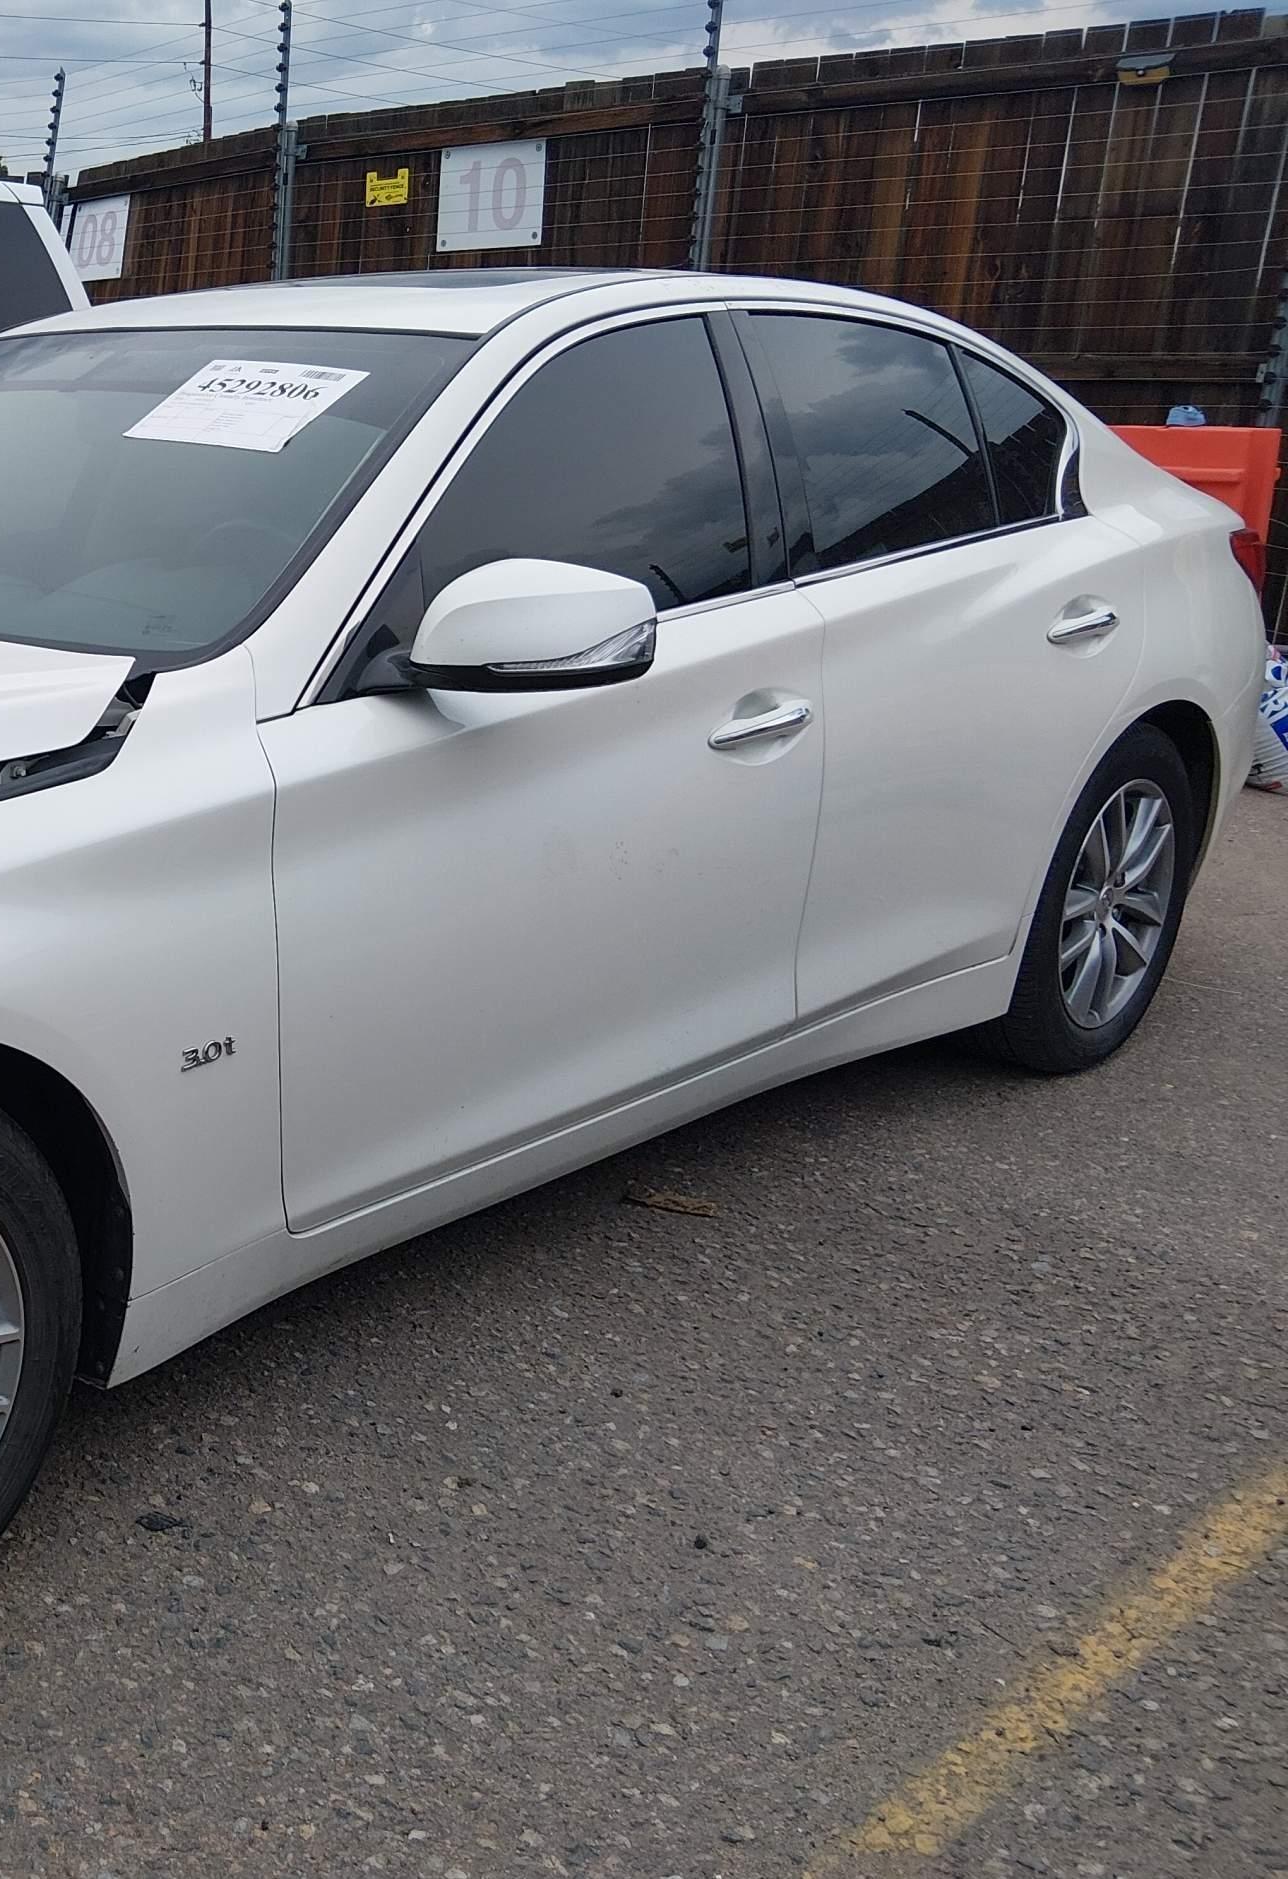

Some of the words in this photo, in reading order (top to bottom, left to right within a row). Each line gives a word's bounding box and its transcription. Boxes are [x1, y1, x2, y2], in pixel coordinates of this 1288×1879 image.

[459, 157, 527, 232] 10
[77, 211, 117, 269] 08
[197, 377, 328, 401] 45292806
[180, 1036, 236, 1073] 3.0t
